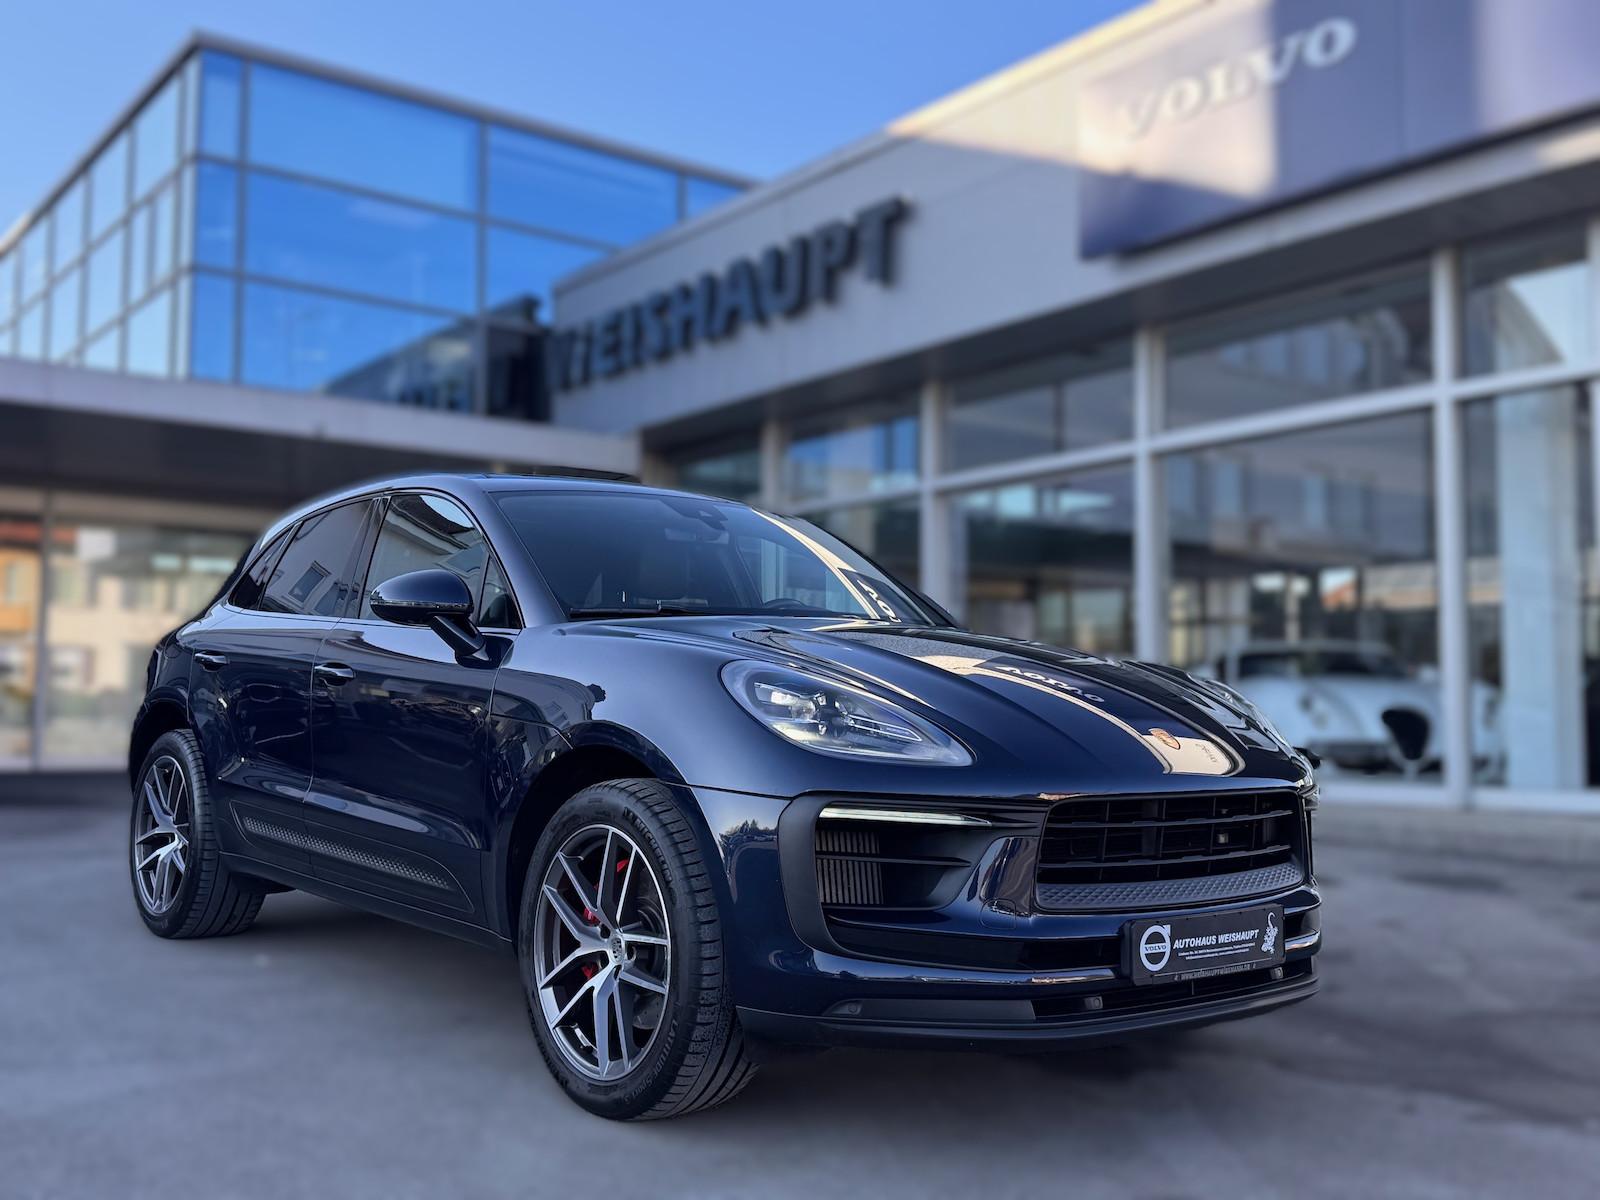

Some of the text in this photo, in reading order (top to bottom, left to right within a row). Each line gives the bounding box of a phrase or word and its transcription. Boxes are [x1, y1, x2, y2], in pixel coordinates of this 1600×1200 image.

[1115, 17, 1357, 139] VOLVO
[546, 196, 913, 391] WEISHAUPT
[1172, 934, 1217, 950] AUTOHAUS
[1218, 928, 1260, 944] WEISHAUPT
